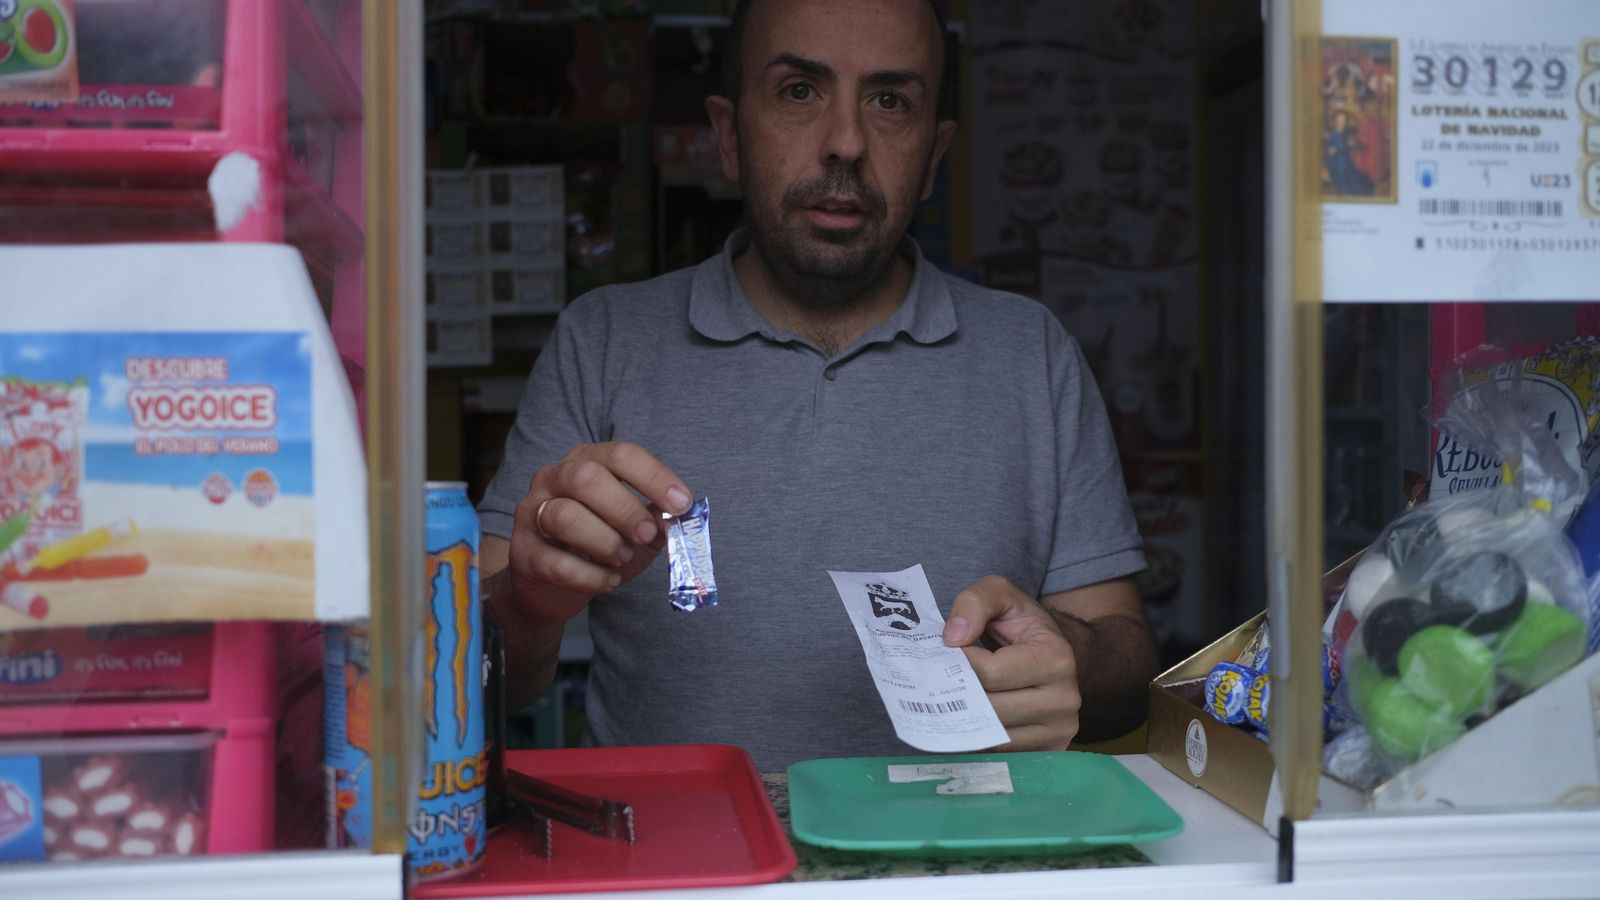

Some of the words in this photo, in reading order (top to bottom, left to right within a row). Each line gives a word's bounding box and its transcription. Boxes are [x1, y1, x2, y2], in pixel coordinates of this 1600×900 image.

[1412, 55, 1567, 92] 30129
[1411, 103, 1481, 118] LOTERÍA
[1487, 106, 1568, 120] NACIONAL
[1440, 124, 1461, 136] DE
[1467, 124, 1541, 137] NAVIDAD
[1438, 139, 1452, 151] de
[1456, 139, 1511, 152] diciembre
[1516, 141, 1529, 152] de
[126, 356, 228, 380] DESCUBRE
[131, 389, 273, 426] YOGOICE
[1213, 670, 1242, 719] KOJAK
